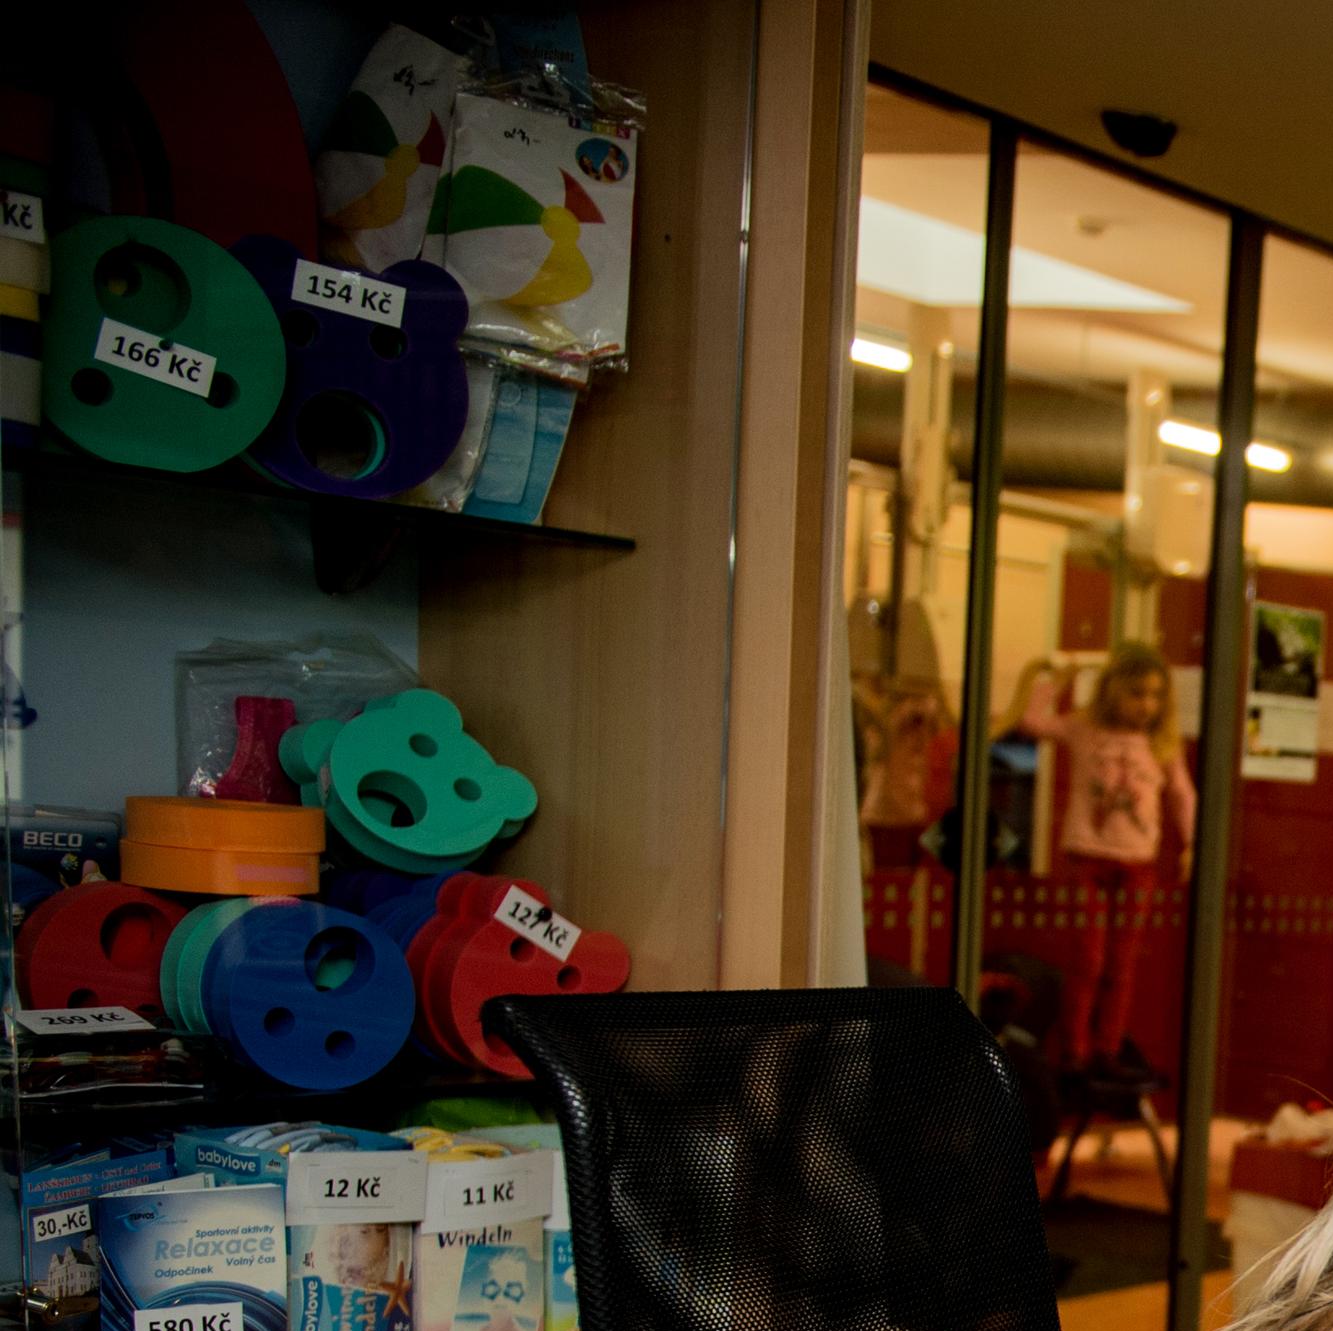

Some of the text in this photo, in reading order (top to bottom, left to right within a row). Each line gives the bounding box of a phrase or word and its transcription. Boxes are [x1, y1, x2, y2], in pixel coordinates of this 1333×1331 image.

[308, 274, 393, 316] 154 Kč
[111, 335, 202, 384] 166 Kč
[23, 831, 83, 848] BECO
[543, 922, 569, 949] Kč
[41, 1012, 125, 1025] 269 Kč
[197, 1147, 257, 1173] babylove
[324, 1177, 381, 1198] 12 Kč
[463, 1180, 515, 1206] 11 Kč
[37, 1211, 88, 1238] 30,-Kč
[195, 1225, 275, 1239] Sportovní aktivity
[437, 1225, 512, 1248] Windeln
[155, 1236, 276, 1261] Relaxace
[154, 1265, 214, 1279] Odpočinek
[226, 1255, 276, 1268] Volný čas
